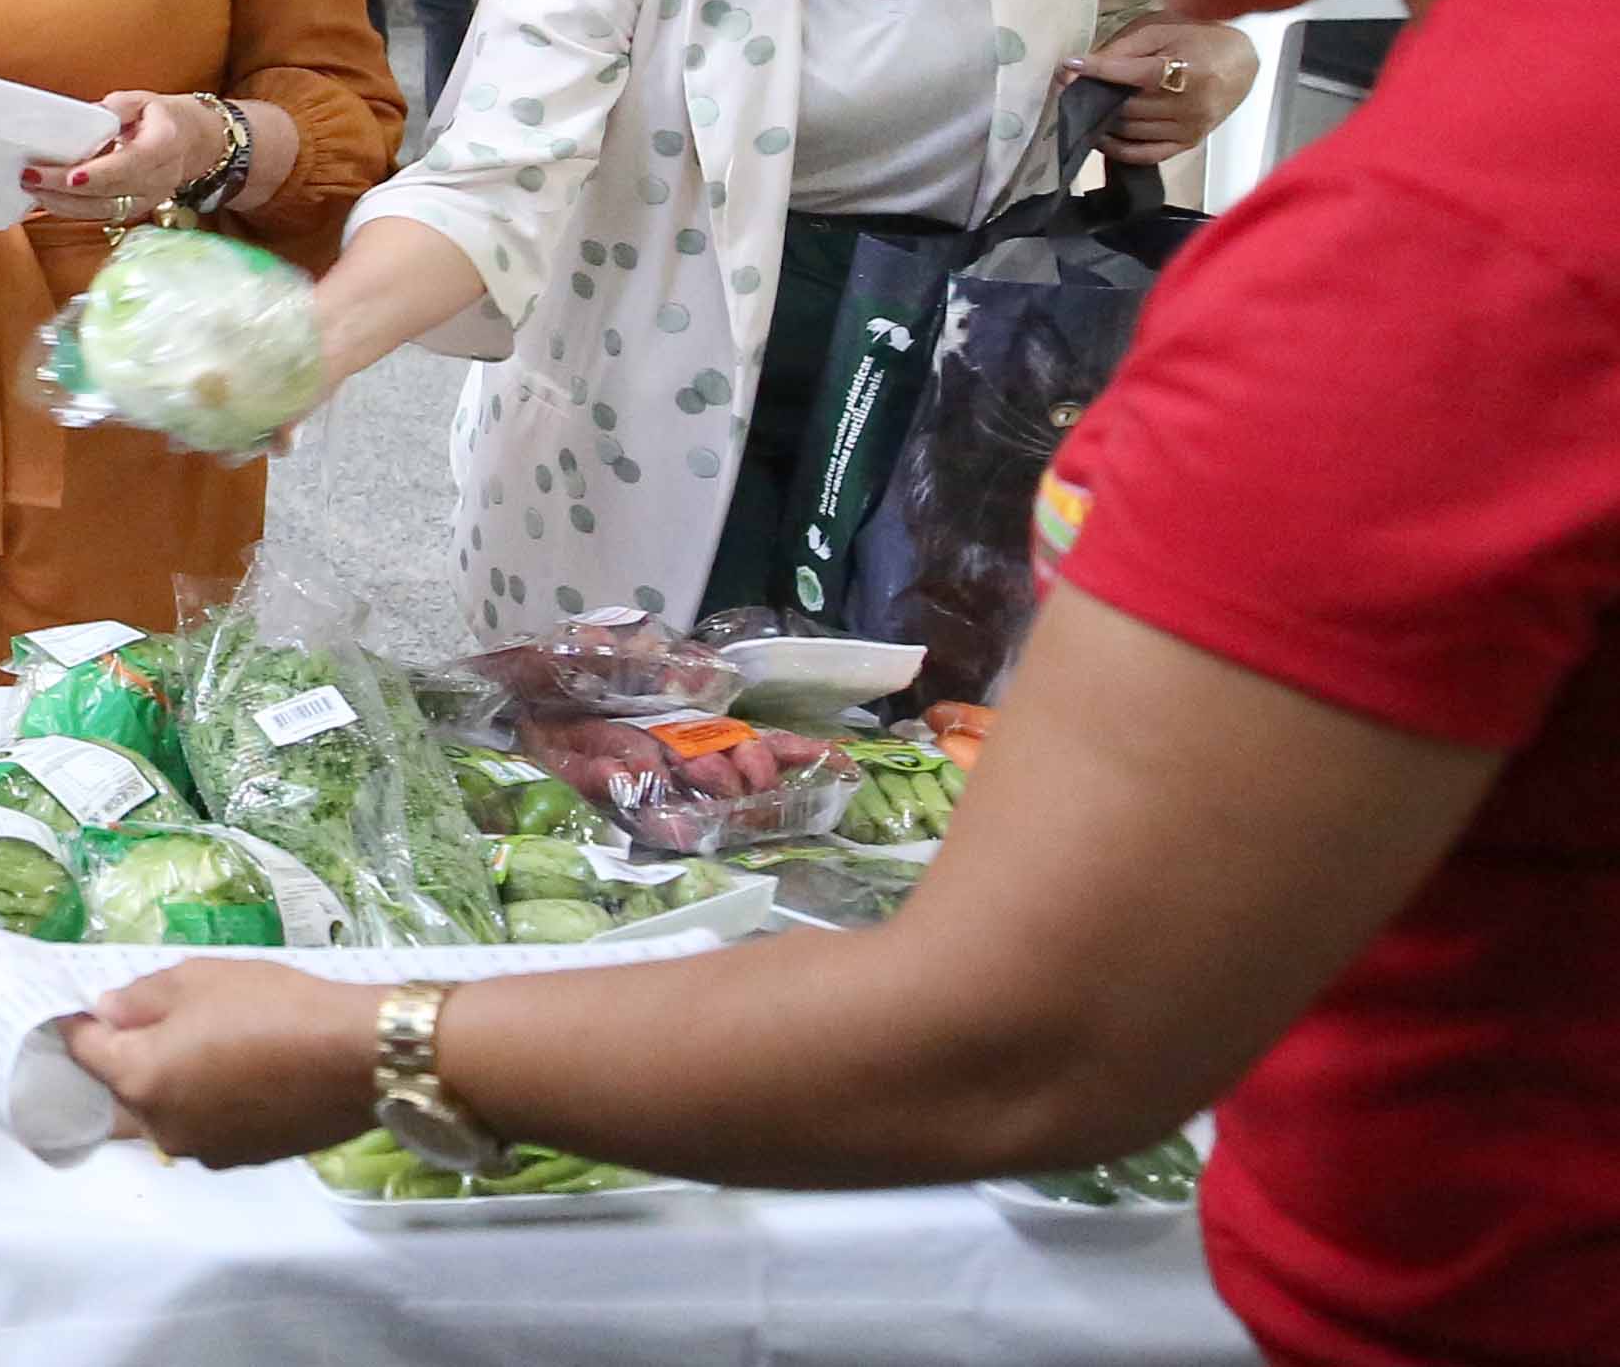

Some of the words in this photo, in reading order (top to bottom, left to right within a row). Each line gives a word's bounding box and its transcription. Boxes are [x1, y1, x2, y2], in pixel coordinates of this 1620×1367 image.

[832, 410, 852, 456] sacolas
[845, 354, 876, 412] plásticas
[832, 447, 852, 494] sacolas
